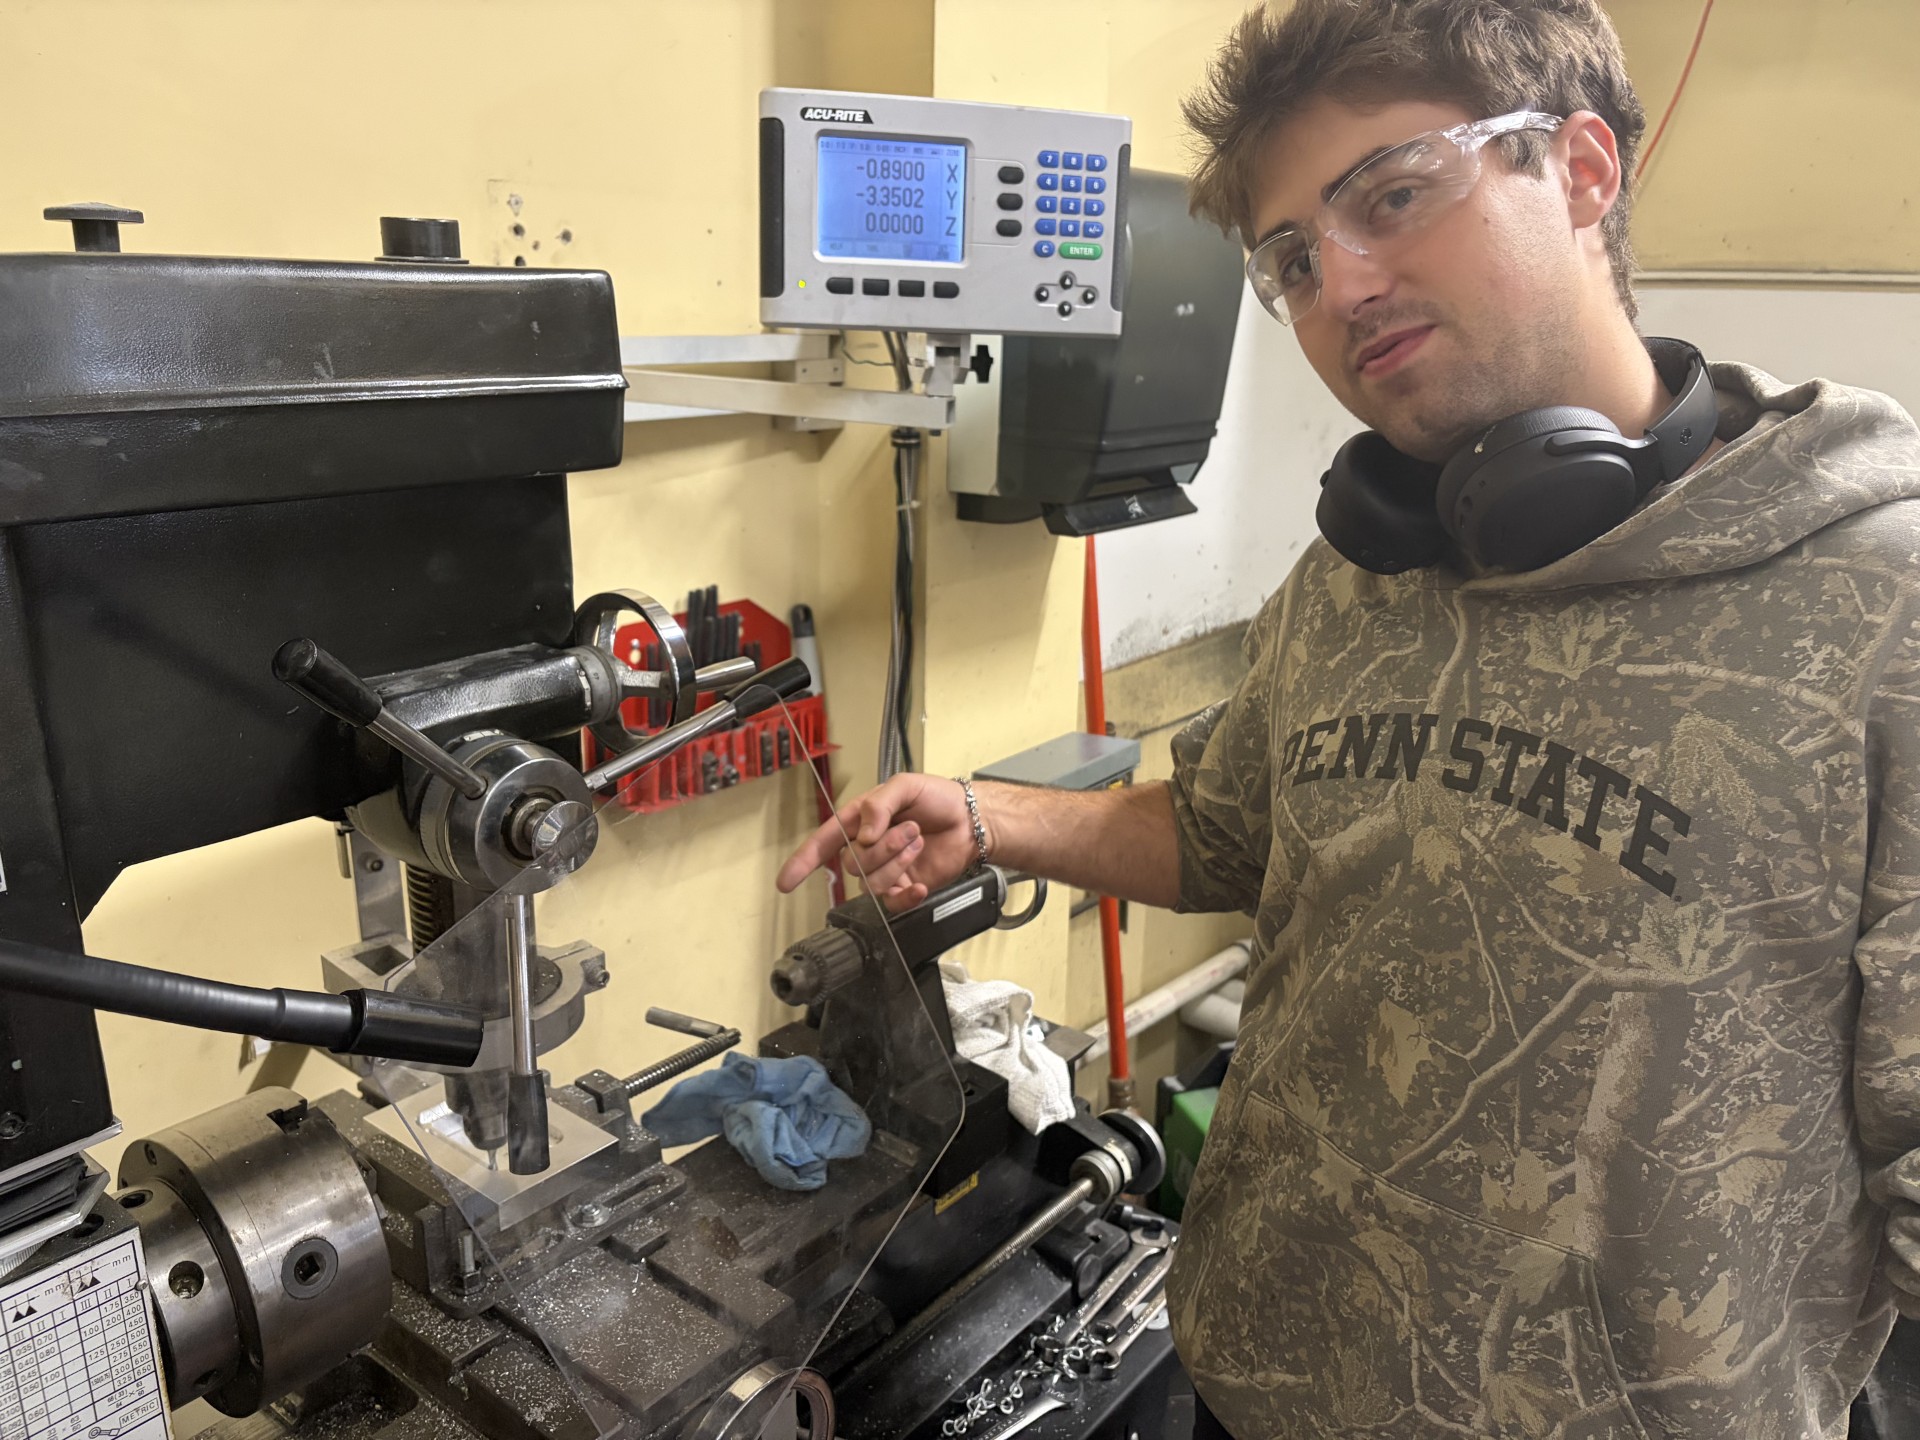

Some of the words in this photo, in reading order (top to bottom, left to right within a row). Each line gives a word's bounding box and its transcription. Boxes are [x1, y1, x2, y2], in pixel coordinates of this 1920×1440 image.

[804, 108, 865, 122] ACU-RITE
[1047, 155, 1053, 163] 7
[856, 158, 925, 182] -0.8900
[947, 164, 958, 184] X
[1045, 178, 1052, 186] 4
[856, 185, 925, 208] -3.3502
[947, 191, 957, 209] Y
[1069, 202, 1075, 210] 2
[865, 212, 923, 235] 0.0000
[945, 217, 957, 236] Z
[1041, 245, 1049, 253] C
[1069, 246, 1095, 256] ENTER
[1278, 713, 1439, 797] PENN
[1442, 717, 1692, 898] STATE
[81, 1298, 91, 1311] III
[104, 1288, 112, 1299] II
[104, 1301, 119, 1313] 1.75
[83, 1325, 99, 1337] 1.00
[88, 1349, 105, 1360] 1.25
[112, 1350, 128, 1362] 2.75
[44, 1371, 60, 1383] 1.00
[117, 1375, 132, 1387] 3.25
[121, 1401, 156, 1425] METRIC
